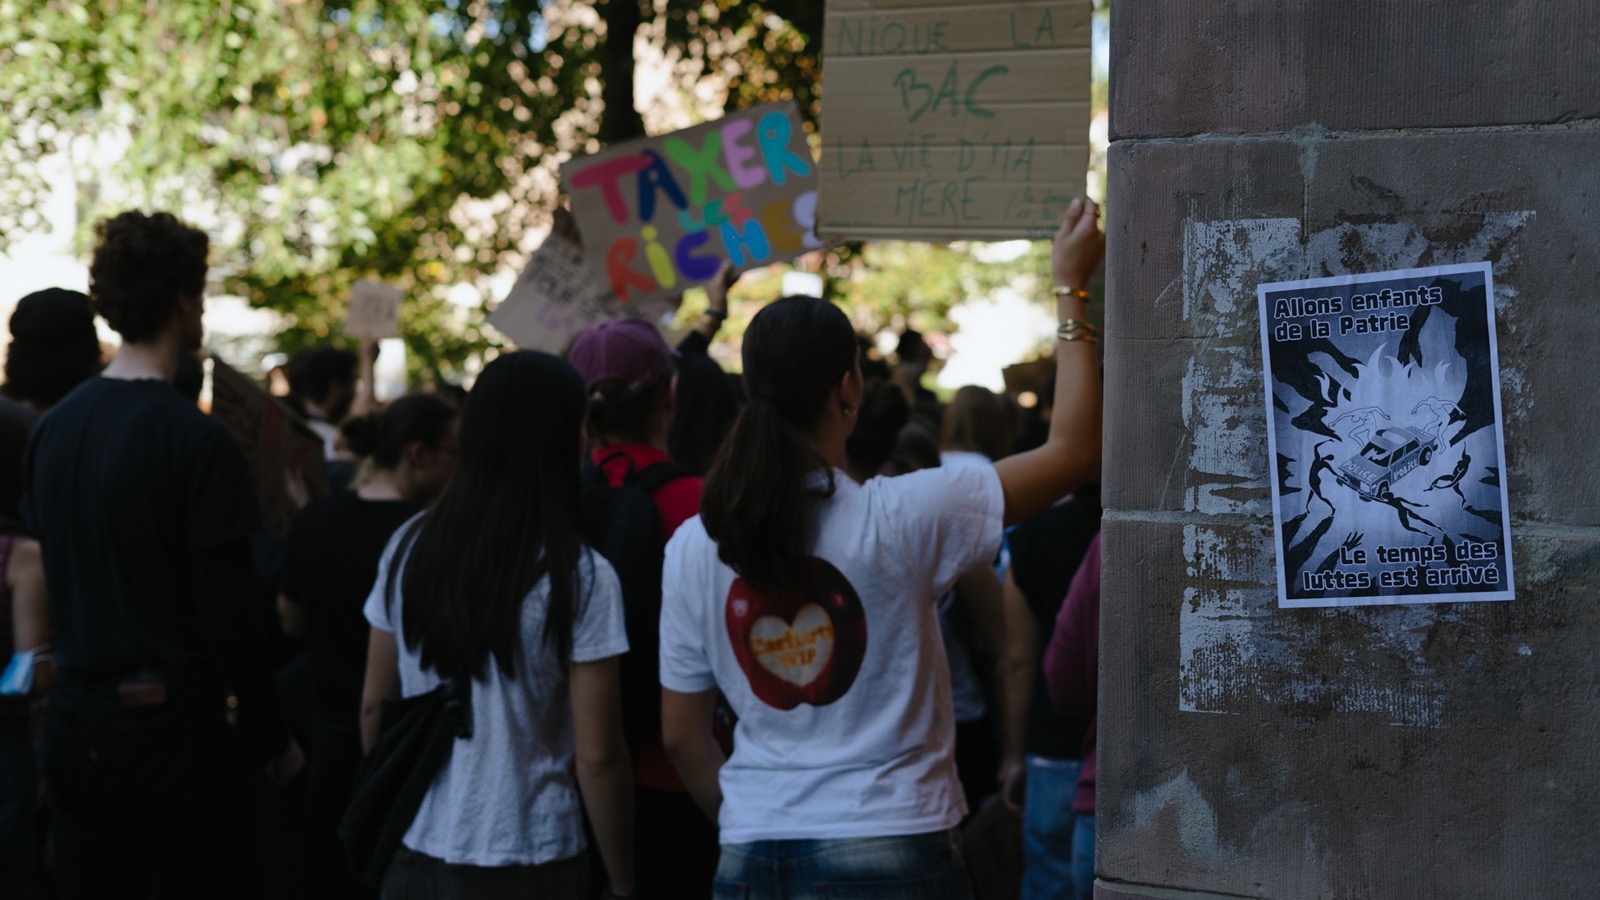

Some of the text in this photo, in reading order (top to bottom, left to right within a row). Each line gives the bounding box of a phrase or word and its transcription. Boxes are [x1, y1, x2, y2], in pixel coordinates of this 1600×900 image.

[1010, 8, 1055, 49] LA
[892, 58, 1009, 123] BAC
[569, 110, 811, 225] TAXER
[836, 135, 875, 180] LA
[678, 192, 754, 234] LES
[1274, 286, 1443, 319] Allons enfants
[1275, 312, 1410, 341] de la Patrie
[1340, 540, 1497, 566] Le temps des
[1303, 562, 1499, 590] luttes est arrivé
